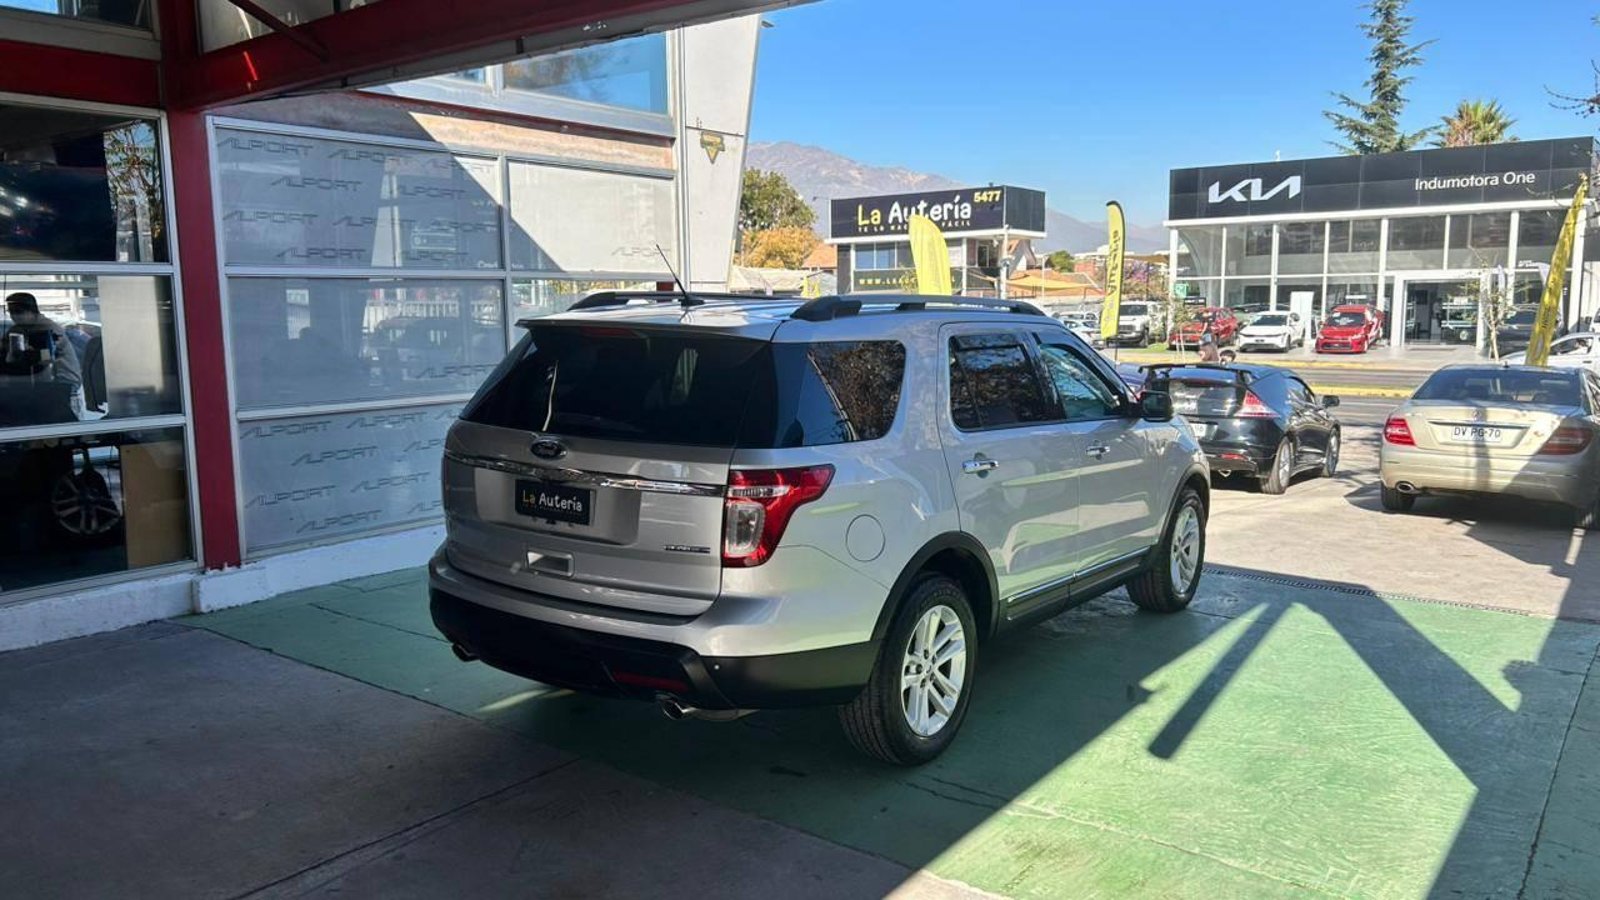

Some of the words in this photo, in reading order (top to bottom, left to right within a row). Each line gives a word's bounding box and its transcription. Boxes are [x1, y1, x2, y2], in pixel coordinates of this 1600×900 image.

[216, 136, 314, 157] ALPORT
[270, 175, 362, 192] ALPORT
[1208, 175, 1301, 204] KIA
[1415, 174, 1500, 191] Indumotora
[1503, 171, 1536, 185] One
[973, 190, 1002, 203] 5477
[223, 210, 318, 226] ALPORT
[857, 204, 881, 226] La
[888, 194, 972, 224] Autería
[276, 248, 367, 259] ALPORT
[240, 420, 331, 440] ALPORT
[346, 411, 428, 430] ALPORT
[291, 445, 378, 466] ALPORT
[245, 485, 337, 509] ALPORT
[350, 472, 429, 494] ALPORT
[523, 489, 535, 504] La
[296, 509, 383, 534] ALPORT
